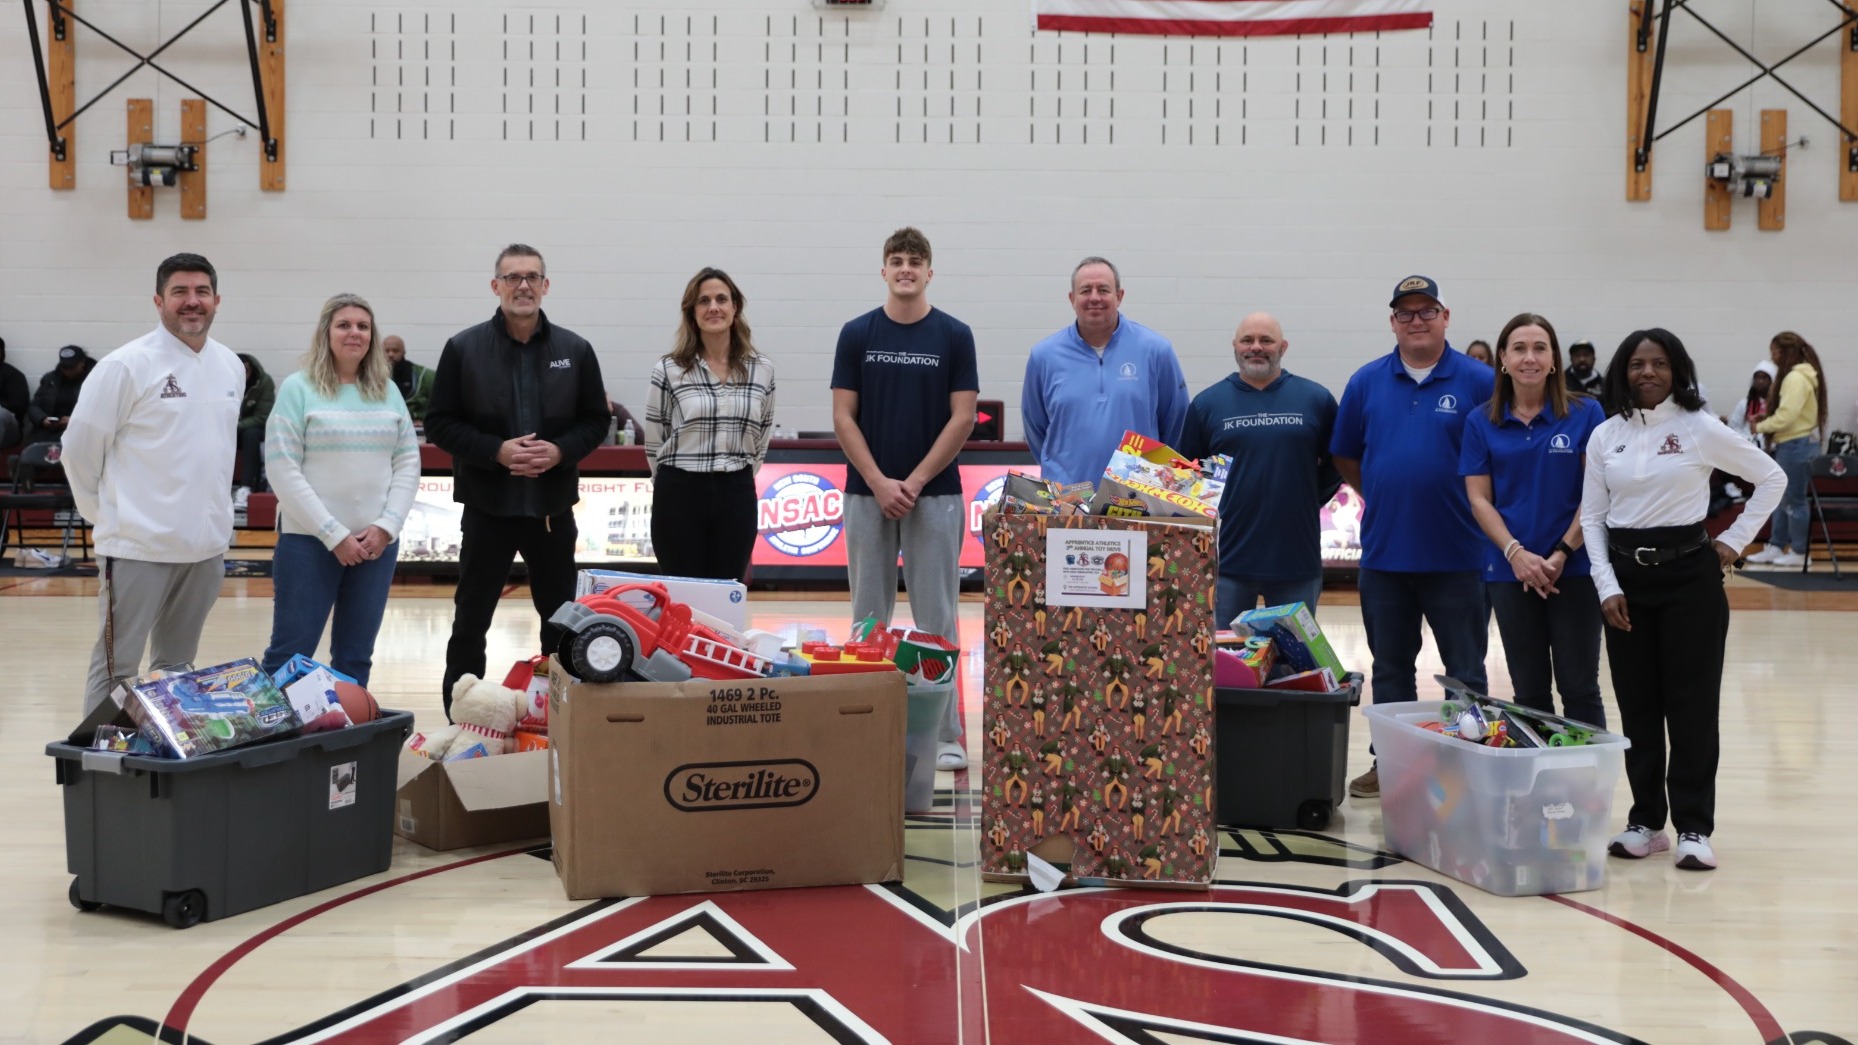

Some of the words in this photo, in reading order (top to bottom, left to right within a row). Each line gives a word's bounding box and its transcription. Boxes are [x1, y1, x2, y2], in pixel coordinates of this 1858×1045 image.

[550, 358, 571, 368] ALIVE
[865, 354, 876, 363] JK
[877, 354, 939, 367] FOUNDATION
[1223, 420, 1234, 431] JK
[1235, 416, 1303, 428] FOUNDATION
[758, 489, 844, 530] NSAC
[710, 688, 742, 702] 1469
[747, 687, 755, 700] 2
[760, 687, 779, 700] Pc.
[707, 704, 718, 713] 40
[720, 703, 738, 713] GAL
[740, 701, 781, 712] WHEELED
[707, 714, 758, 725] INDUSTRIAL
[760, 713, 781, 723] TOTE
[705, 870, 733, 878] Sterilite
